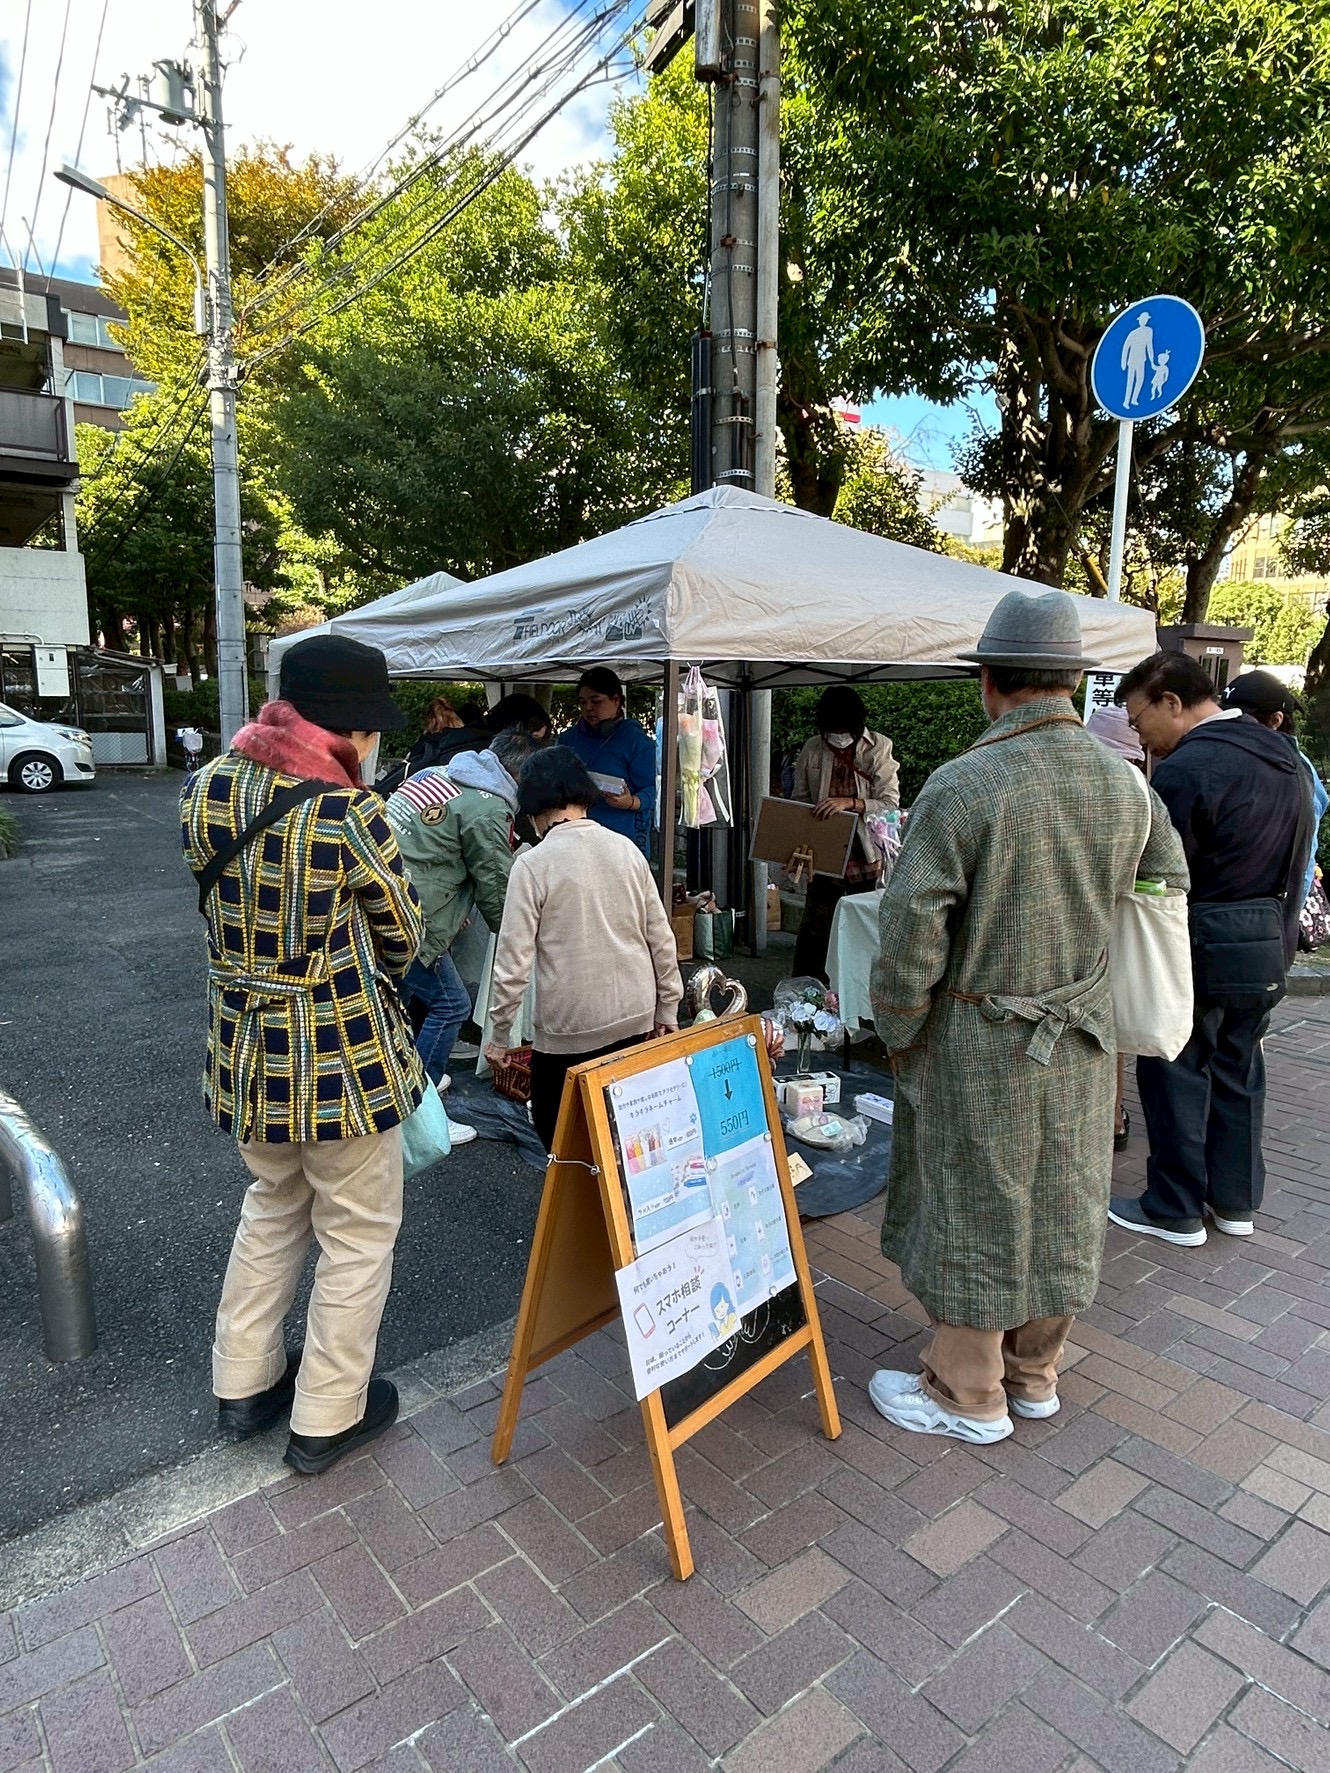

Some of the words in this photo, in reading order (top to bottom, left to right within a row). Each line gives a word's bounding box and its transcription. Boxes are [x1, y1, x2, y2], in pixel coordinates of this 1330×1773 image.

[712, 1057, 741, 1080] 1500円
[630, 1095, 682, 1119] キラキラネームチャーム
[720, 1109, 750, 1136] 550円
[655, 1276, 702, 1316] スマホ相談
[667, 1304, 701, 1335] コーナー
